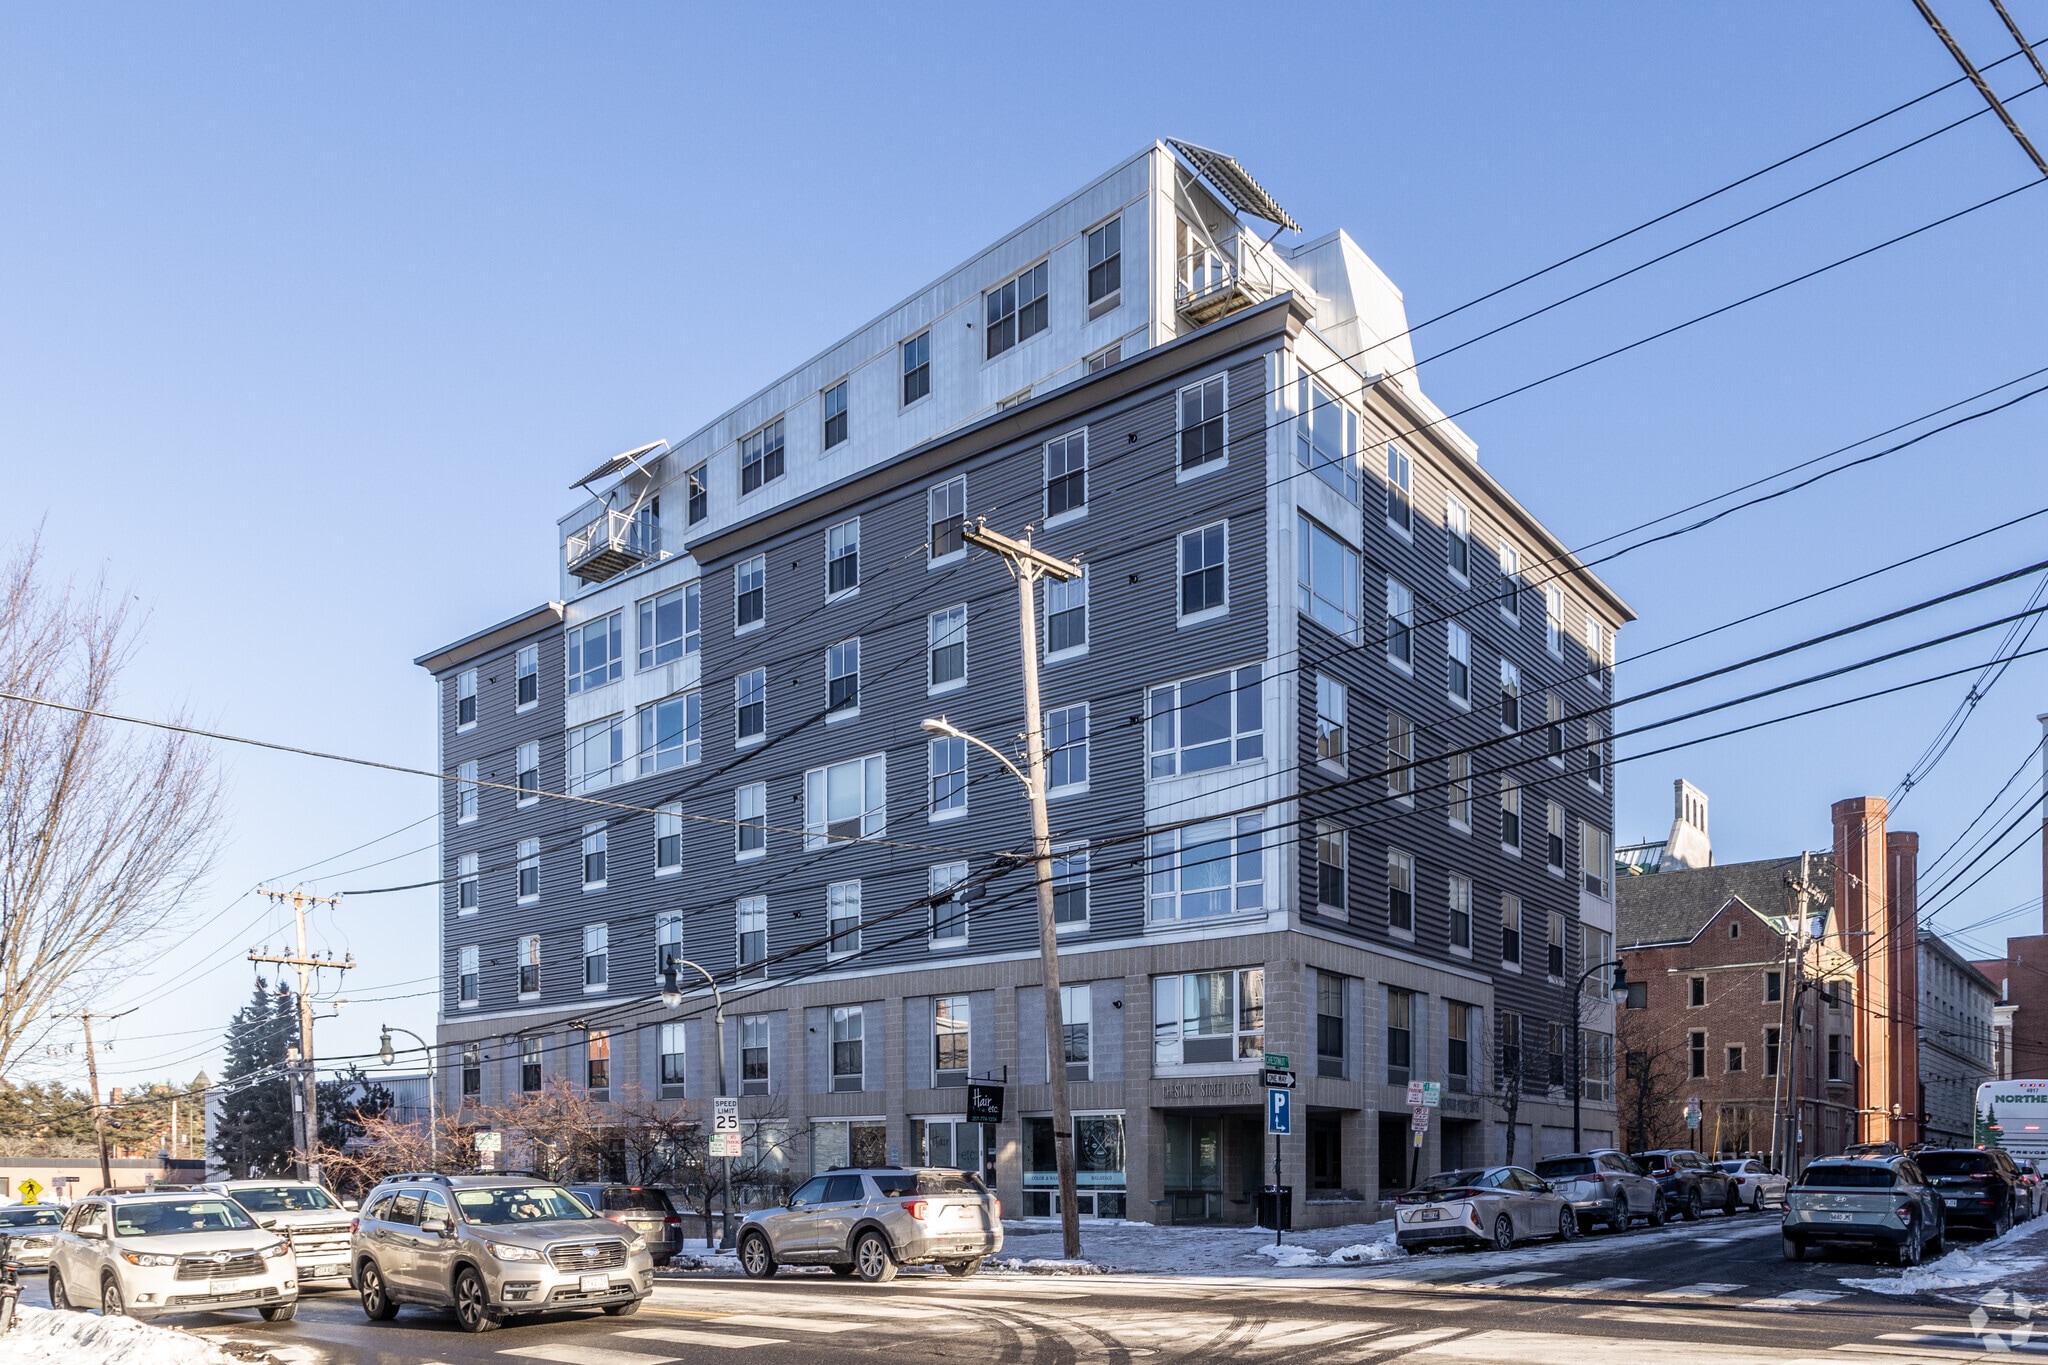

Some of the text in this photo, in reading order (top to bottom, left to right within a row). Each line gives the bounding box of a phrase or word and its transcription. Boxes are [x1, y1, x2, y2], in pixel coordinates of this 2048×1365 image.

[972, 1088, 992, 1108] Hair
[1163, 1082, 1252, 1099] CHESTNUT STREET LOFTS
[1995, 1095, 2048, 1103] NORTHE
[1274, 1093, 1285, 1114] P
[716, 1115, 737, 1129] 25
